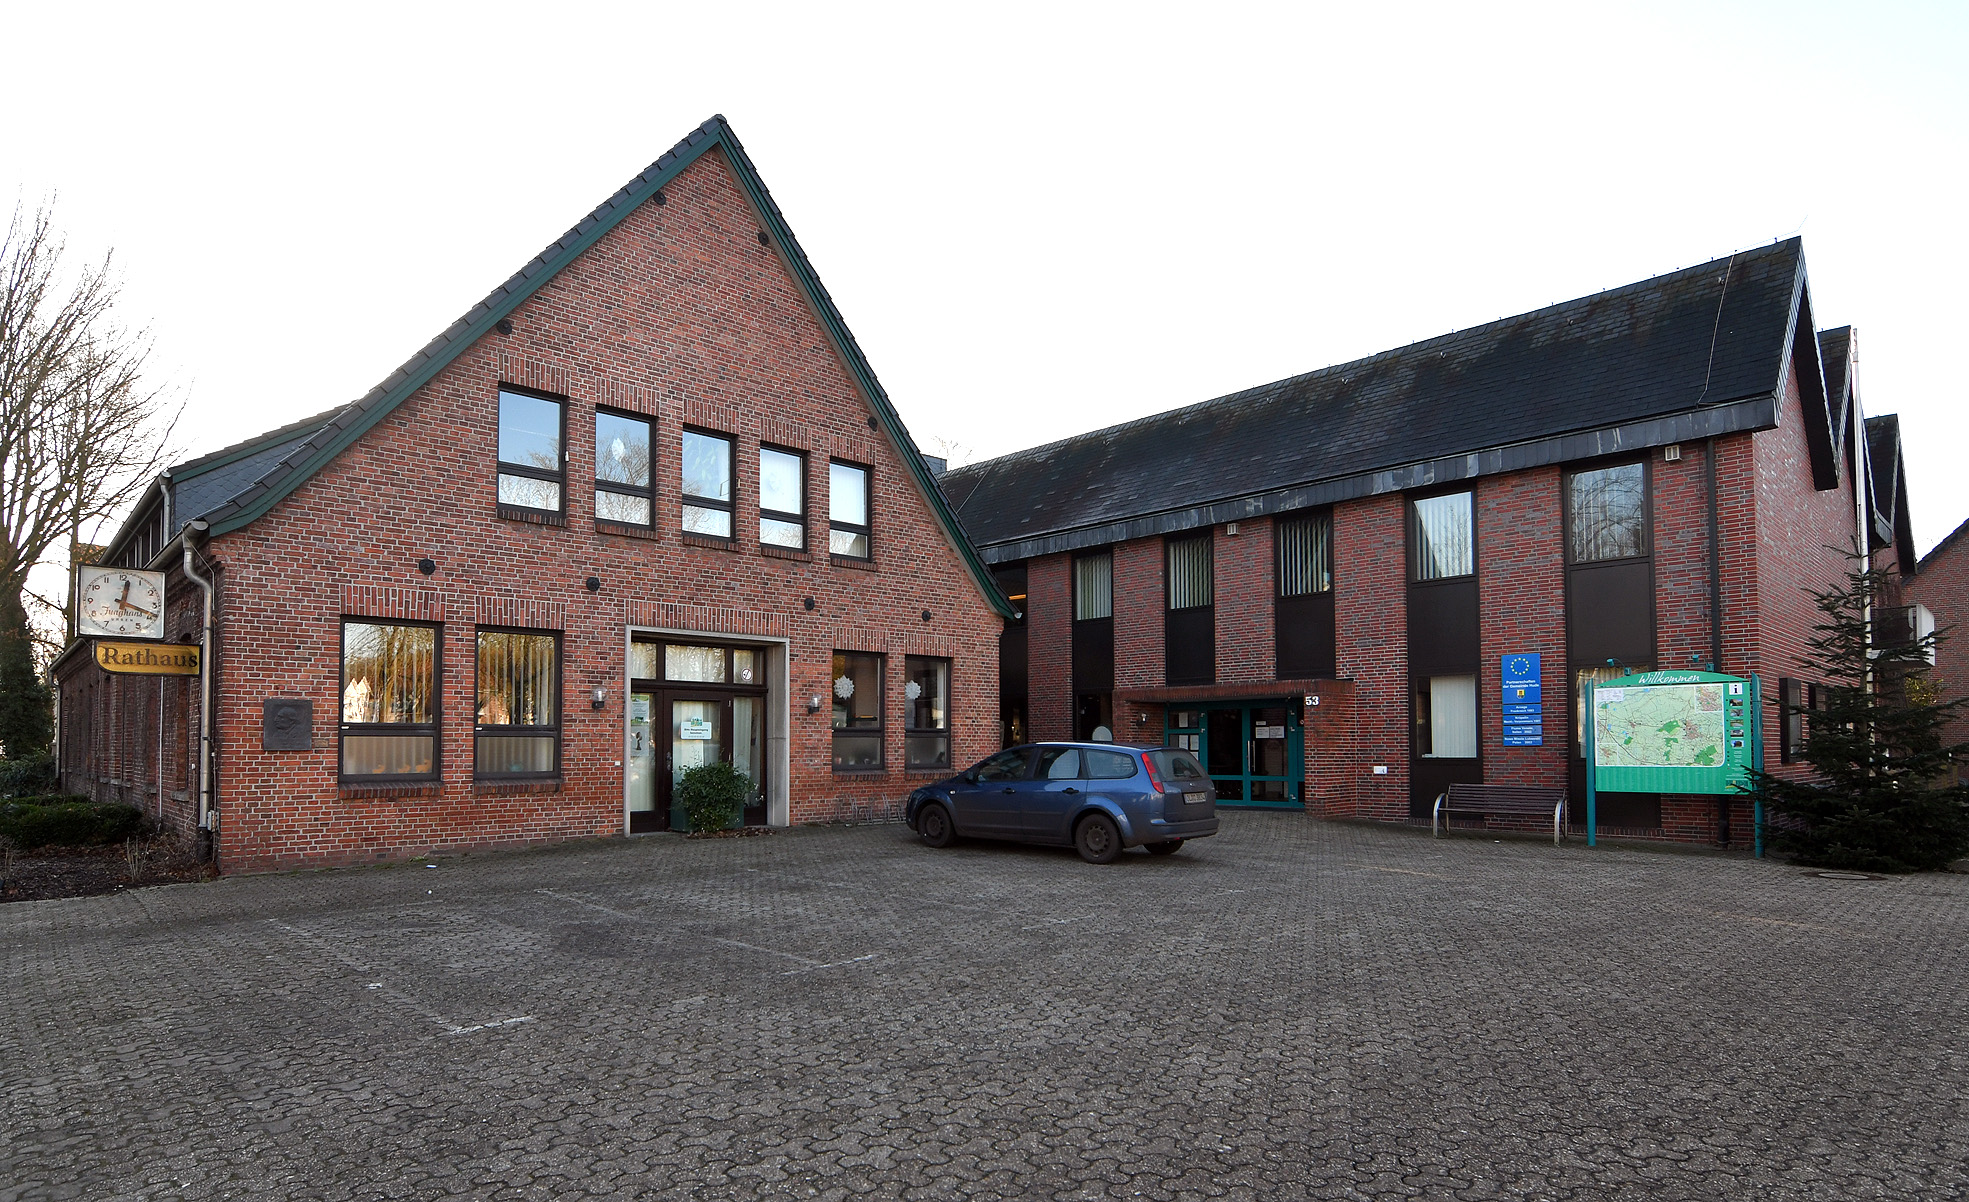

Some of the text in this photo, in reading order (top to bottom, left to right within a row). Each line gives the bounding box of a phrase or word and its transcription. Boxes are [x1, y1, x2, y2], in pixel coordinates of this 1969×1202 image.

[119, 574, 128, 582] 12
[87, 597, 94, 605] 9
[100, 605, 143, 618] Junghans
[103, 620, 110, 628] 7
[135, 622, 142, 630] 5
[102, 647, 198, 668] Rathaus
[1638, 671, 1700, 684] Willkommen
[1305, 695, 1320, 706] 53
